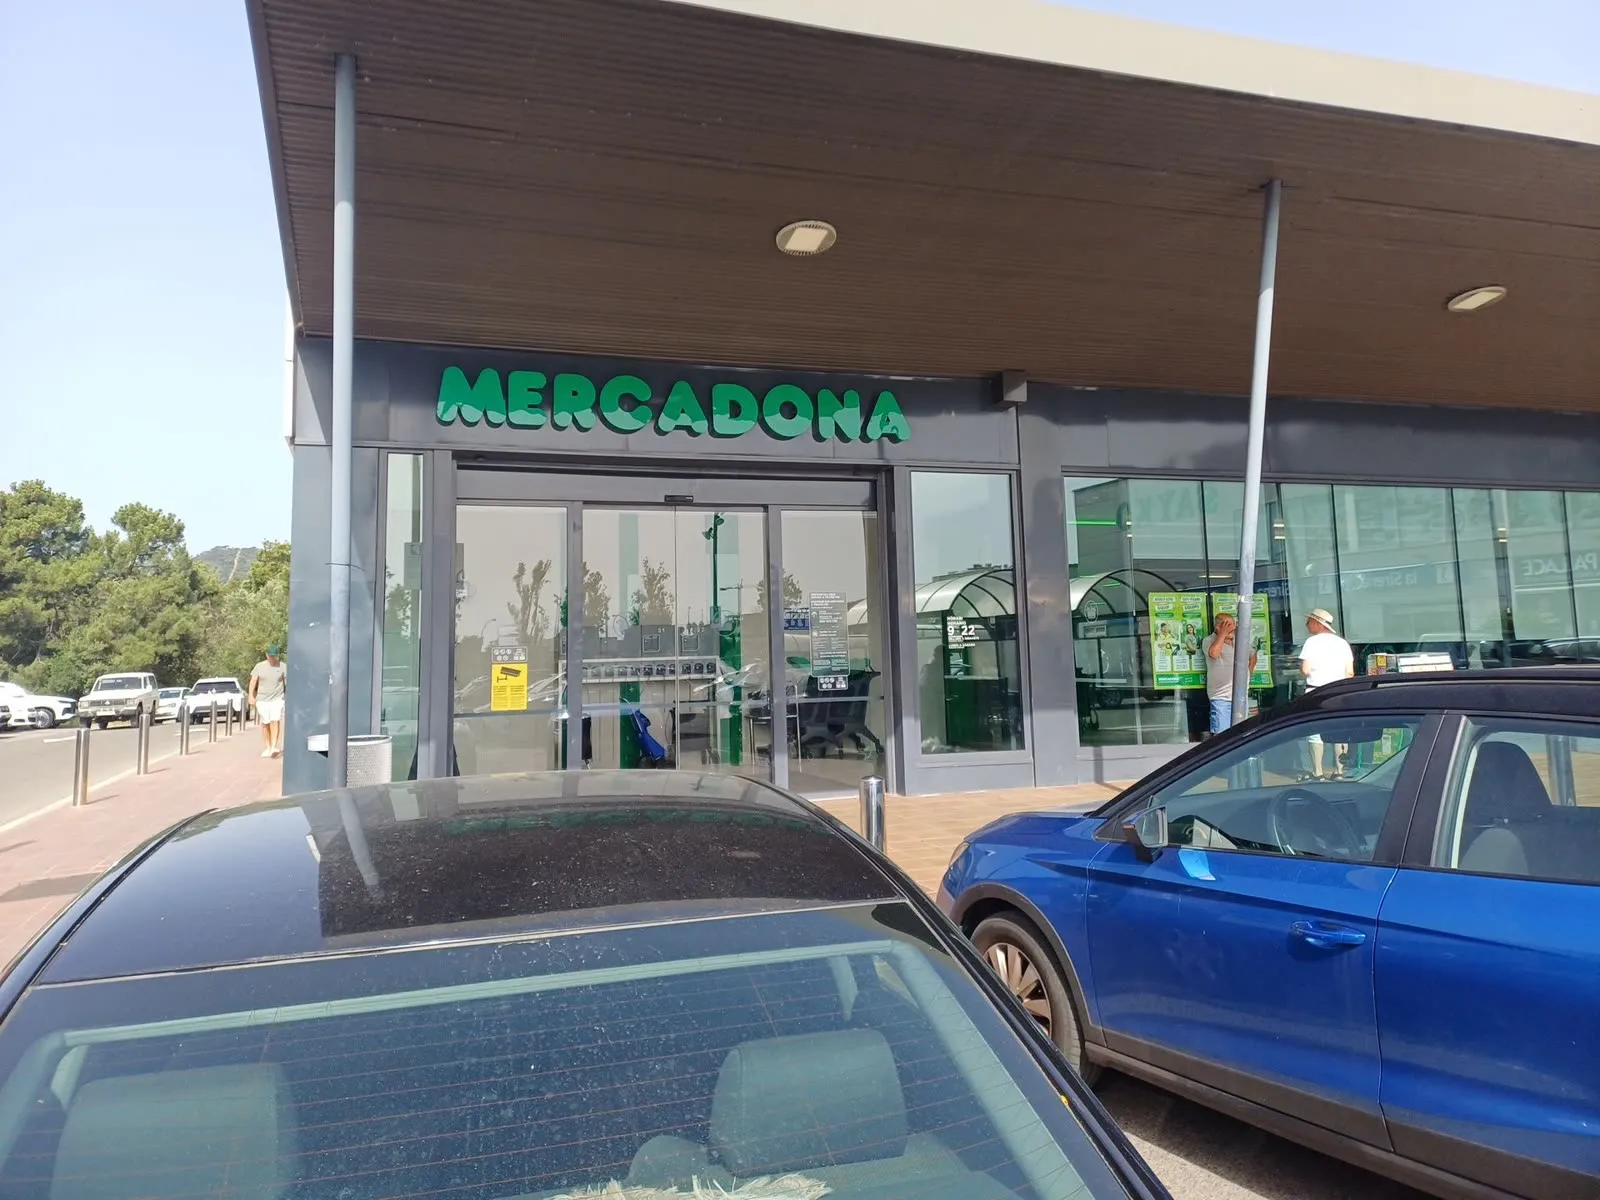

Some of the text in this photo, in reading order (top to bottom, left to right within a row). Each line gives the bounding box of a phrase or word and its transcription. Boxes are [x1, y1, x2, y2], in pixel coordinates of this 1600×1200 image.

[437, 366, 910, 443] MERCADONA
[947, 625, 975, 636] 9 22
